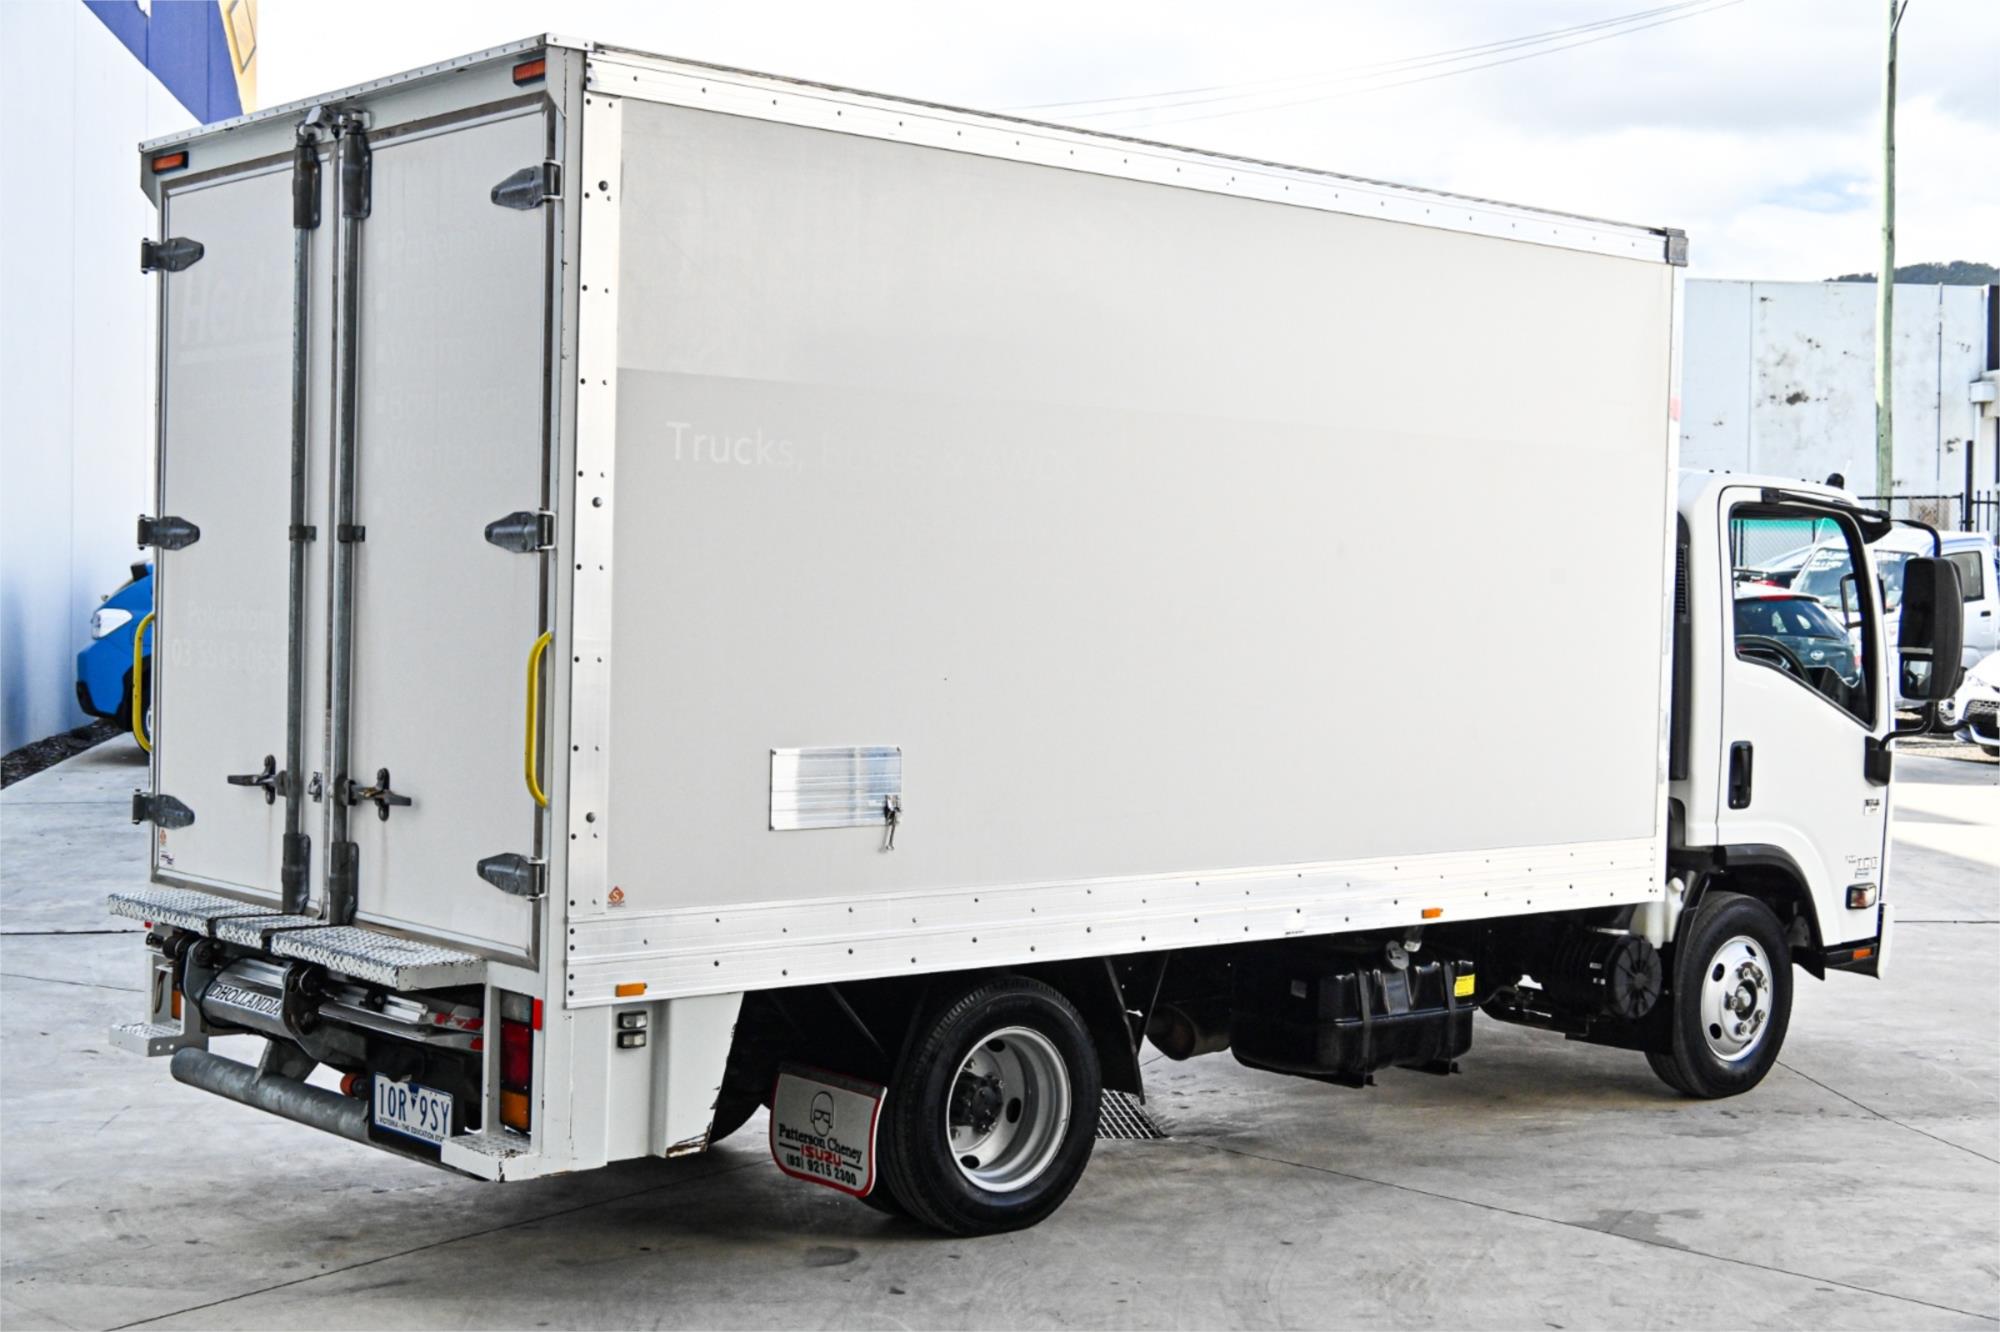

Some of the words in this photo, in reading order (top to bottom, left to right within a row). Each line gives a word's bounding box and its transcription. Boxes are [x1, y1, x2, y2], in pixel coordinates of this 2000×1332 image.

[208, 984, 282, 1016] DHOLLANDIA
[420, 1096, 449, 1134] 9SY
[778, 1123, 826, 1149] Patterson
[827, 1138, 862, 1164] Cheney
[800, 1144, 843, 1167] ISUZU
